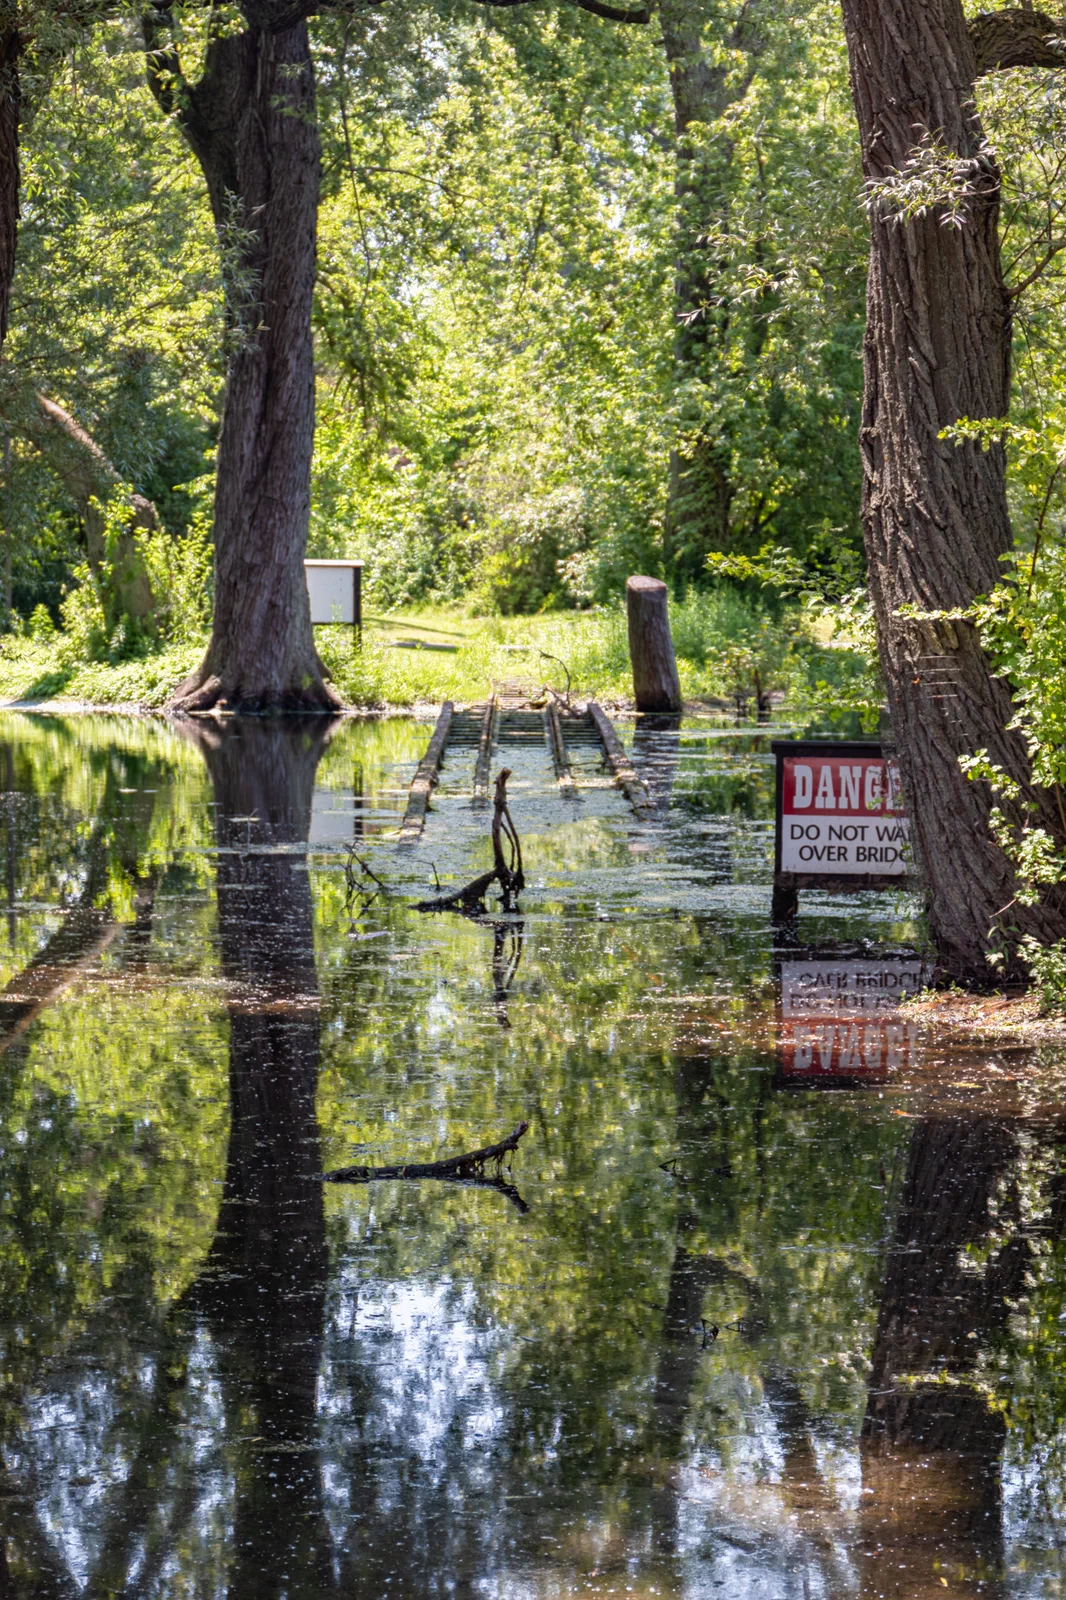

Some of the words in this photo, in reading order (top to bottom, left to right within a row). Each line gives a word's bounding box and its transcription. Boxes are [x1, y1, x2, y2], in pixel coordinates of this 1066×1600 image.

[790, 824, 821, 841] DO
[828, 825, 869, 841] NOT
[875, 826, 911, 842] WA
[799, 845, 848, 861] OVER
